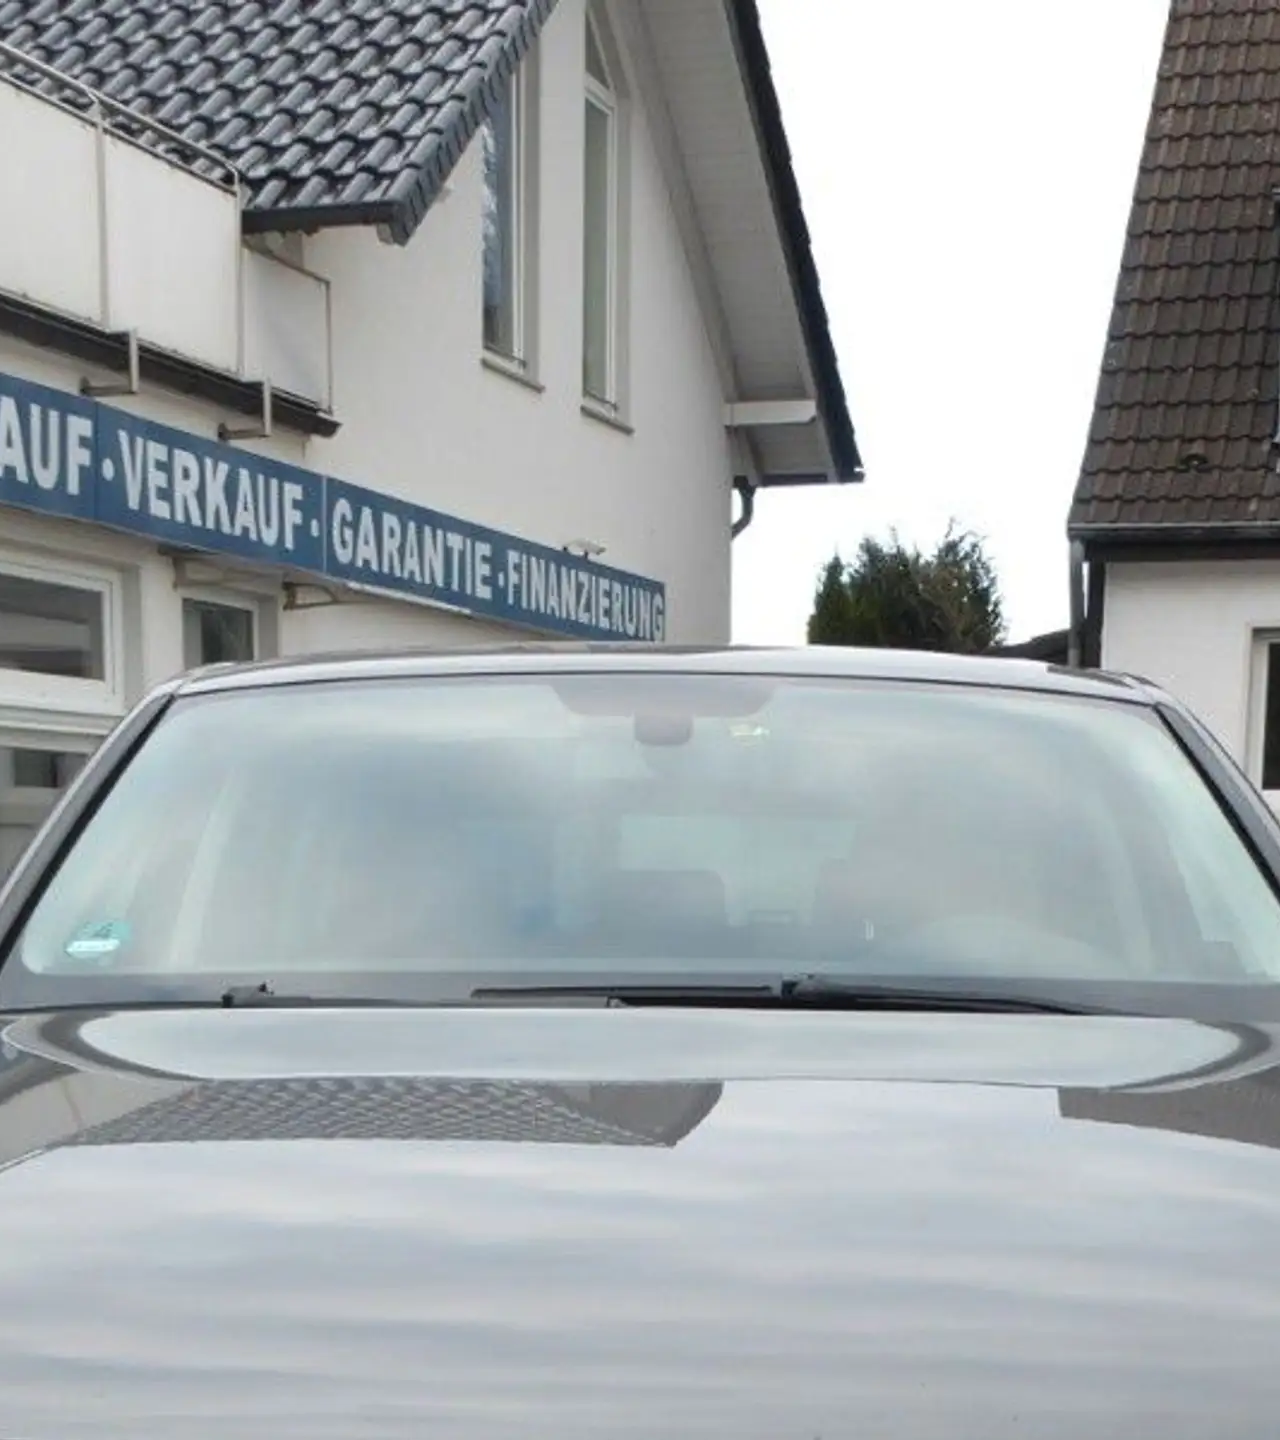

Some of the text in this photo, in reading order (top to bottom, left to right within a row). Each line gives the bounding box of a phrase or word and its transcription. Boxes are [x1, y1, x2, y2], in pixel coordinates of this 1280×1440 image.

[118, 430, 303, 550] VERKAUF
[332, 498, 492, 599] GARANTIE
[506, 550, 664, 641] FINANZIERUNG
